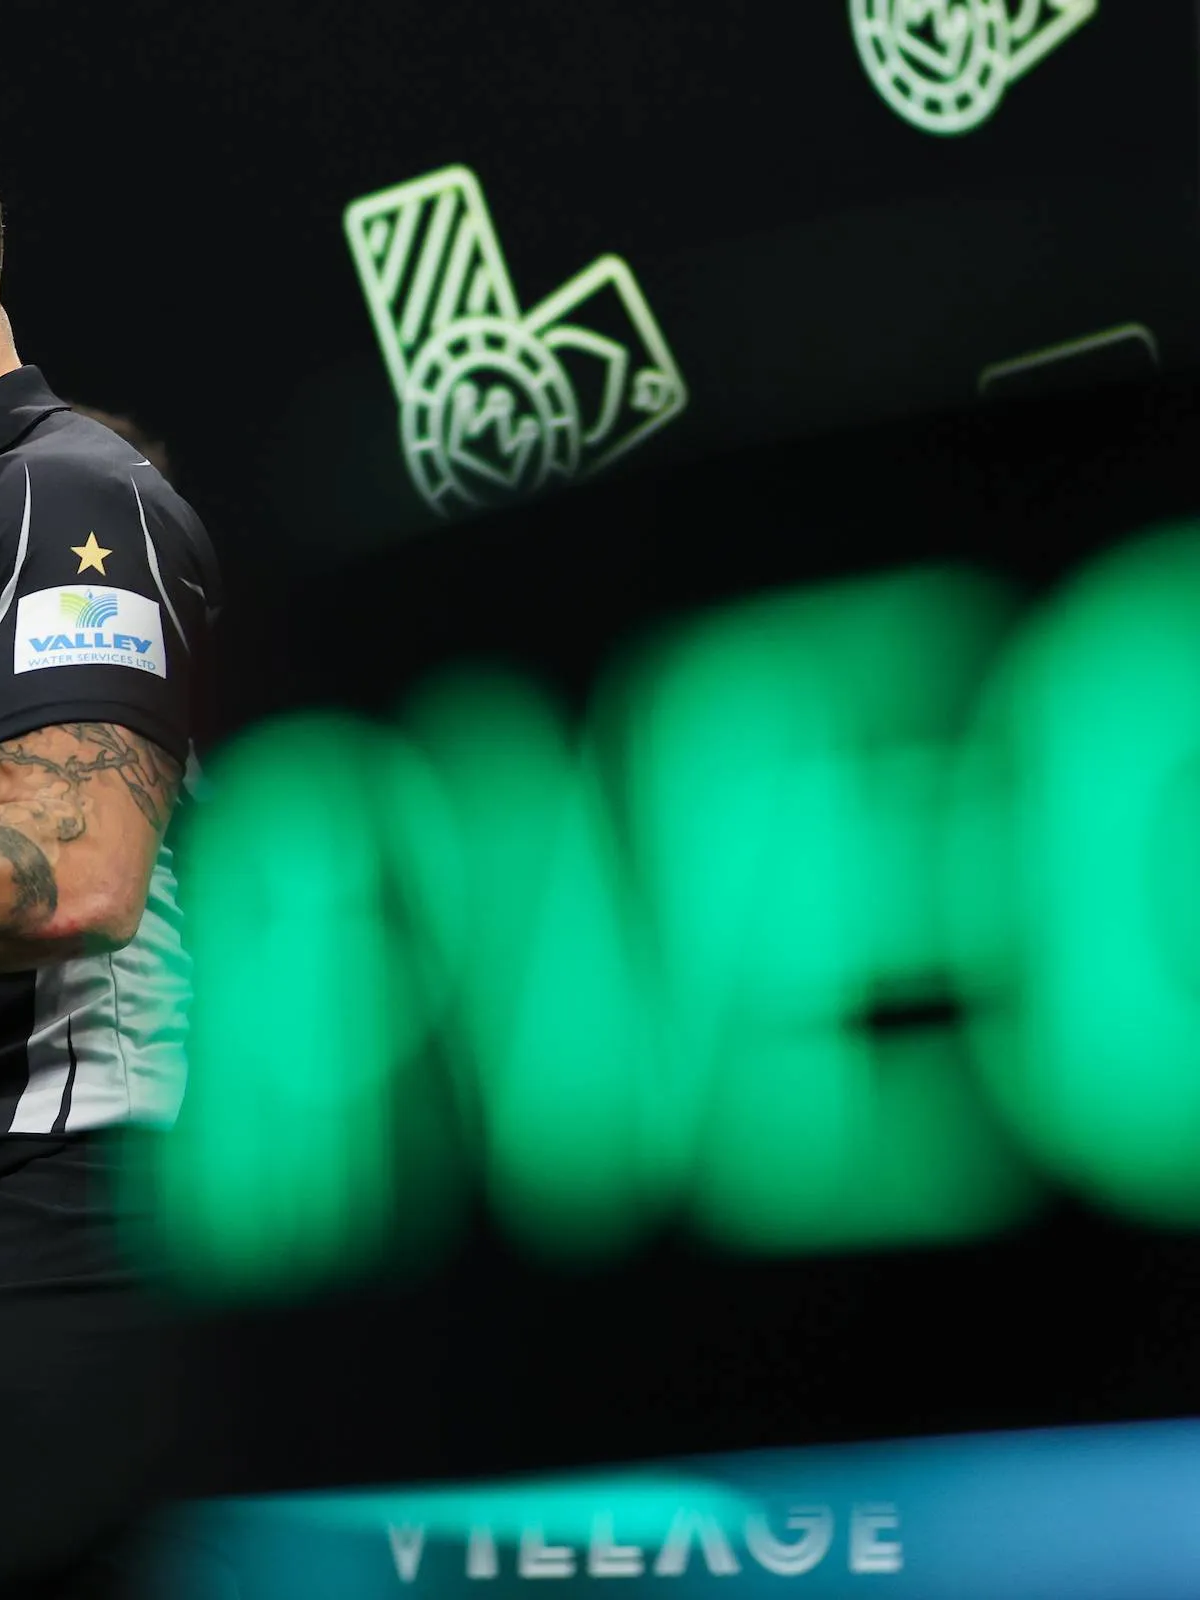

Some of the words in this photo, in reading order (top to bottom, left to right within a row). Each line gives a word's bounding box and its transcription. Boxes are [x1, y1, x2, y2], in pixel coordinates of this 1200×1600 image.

[28, 632, 153, 654] VALLEY
[28, 653, 73, 668] WATER
[77, 651, 134, 665] SERVICES
[135, 656, 157, 671] LTD
[387, 1501, 904, 1584] VILLAGE
